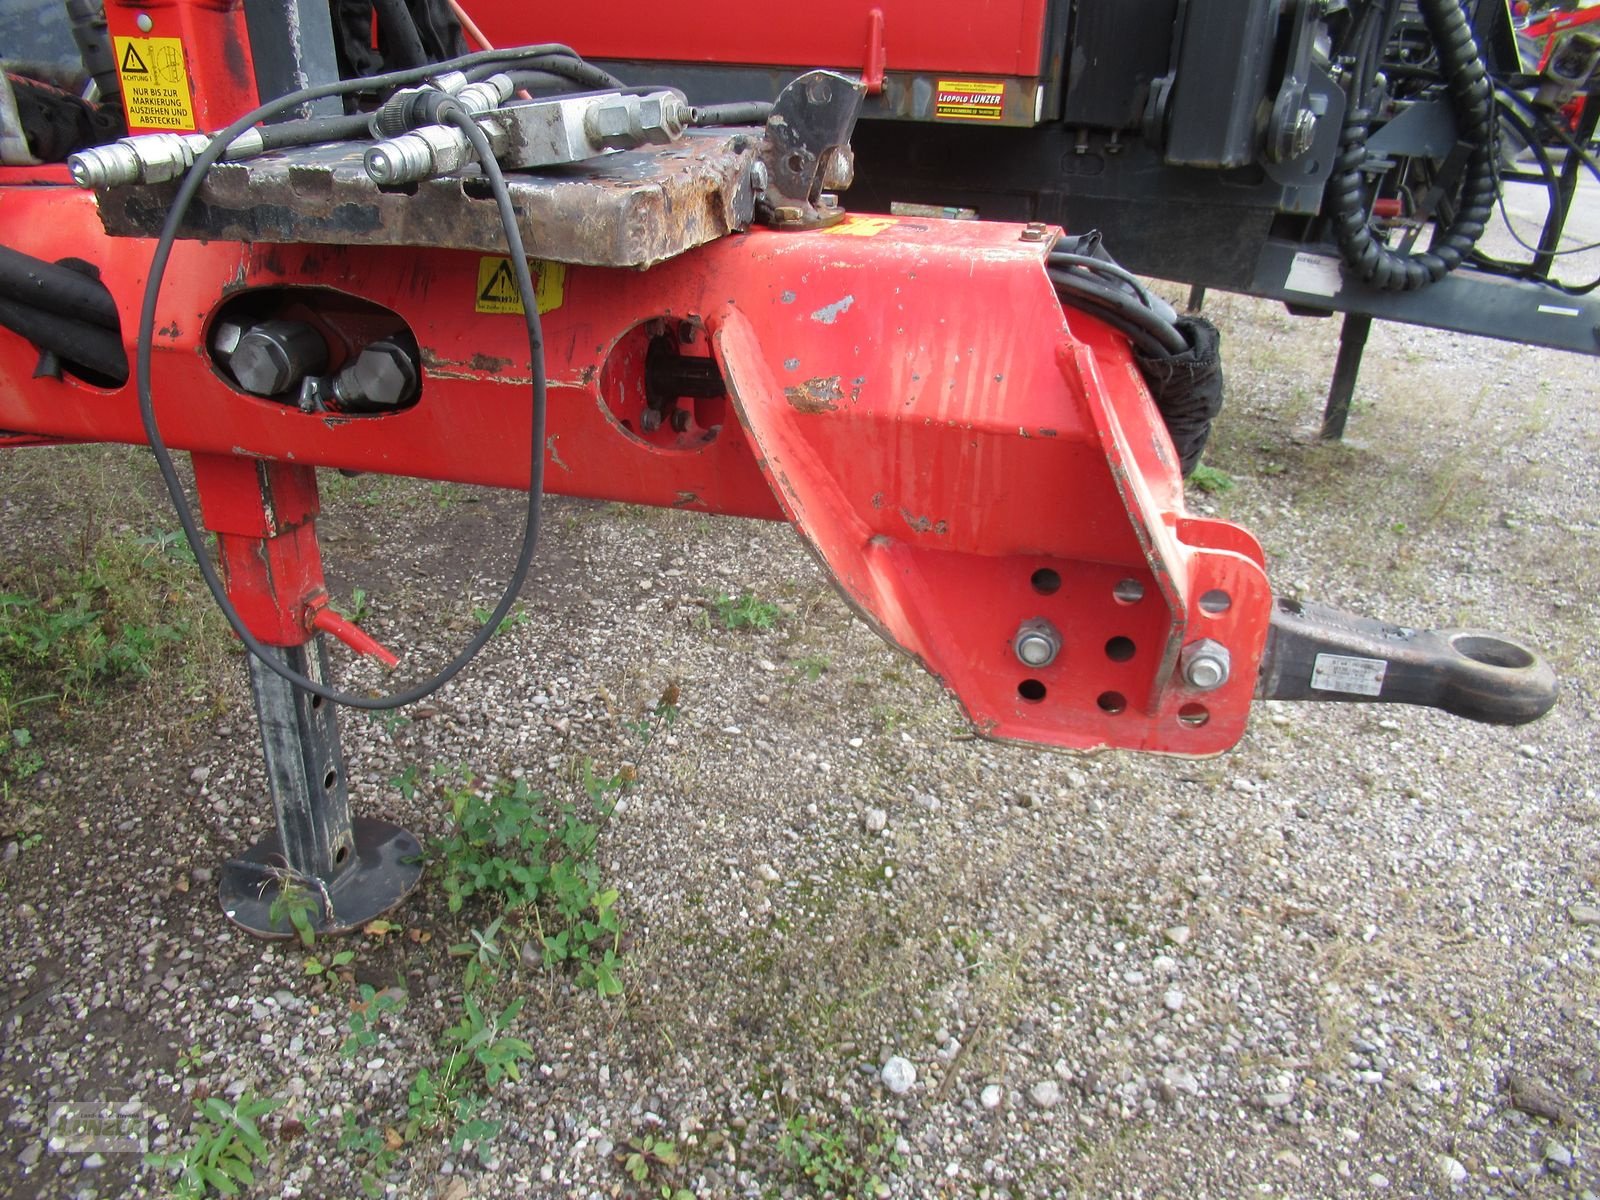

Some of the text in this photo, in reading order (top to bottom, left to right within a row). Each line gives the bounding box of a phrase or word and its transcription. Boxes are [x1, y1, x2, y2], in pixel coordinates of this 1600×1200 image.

[133, 88, 178, 98] NUR BIS ZUR
[132, 97, 182, 107] MARKIERUNG
[970, 94, 1001, 105] LUNZER
[129, 106, 188, 117] AUSZIEHEN UND
[140, 116, 181, 126] ABSTECKEN
